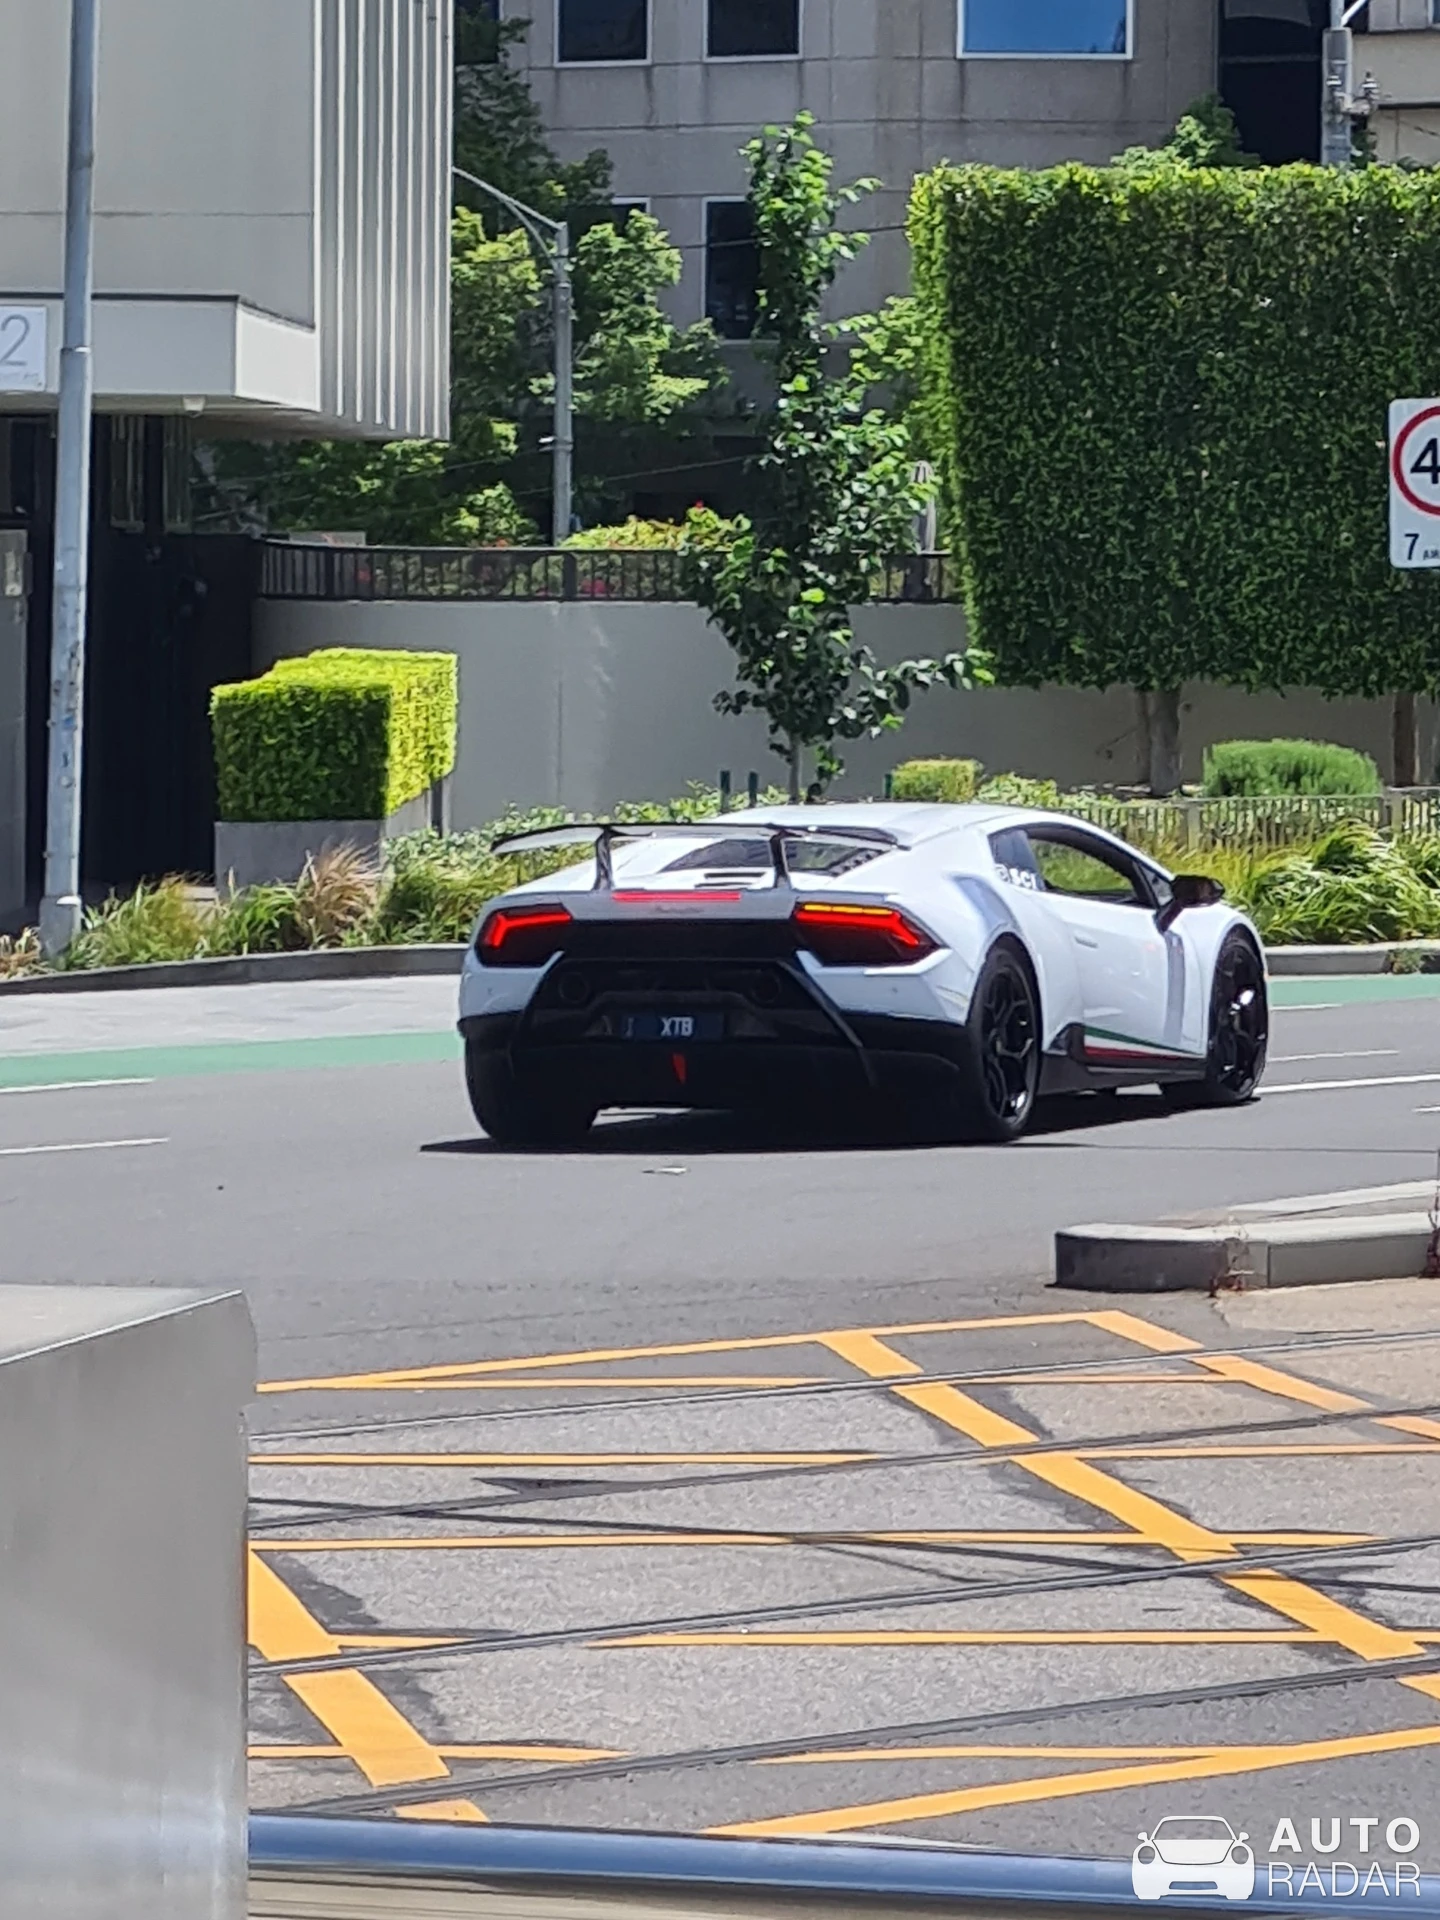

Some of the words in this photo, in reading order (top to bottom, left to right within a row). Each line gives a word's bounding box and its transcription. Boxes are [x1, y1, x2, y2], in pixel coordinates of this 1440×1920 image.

[1, 314, 28, 366] 2
[1404, 533, 1419, 560] 7
[661, 1017, 694, 1036] XTB
